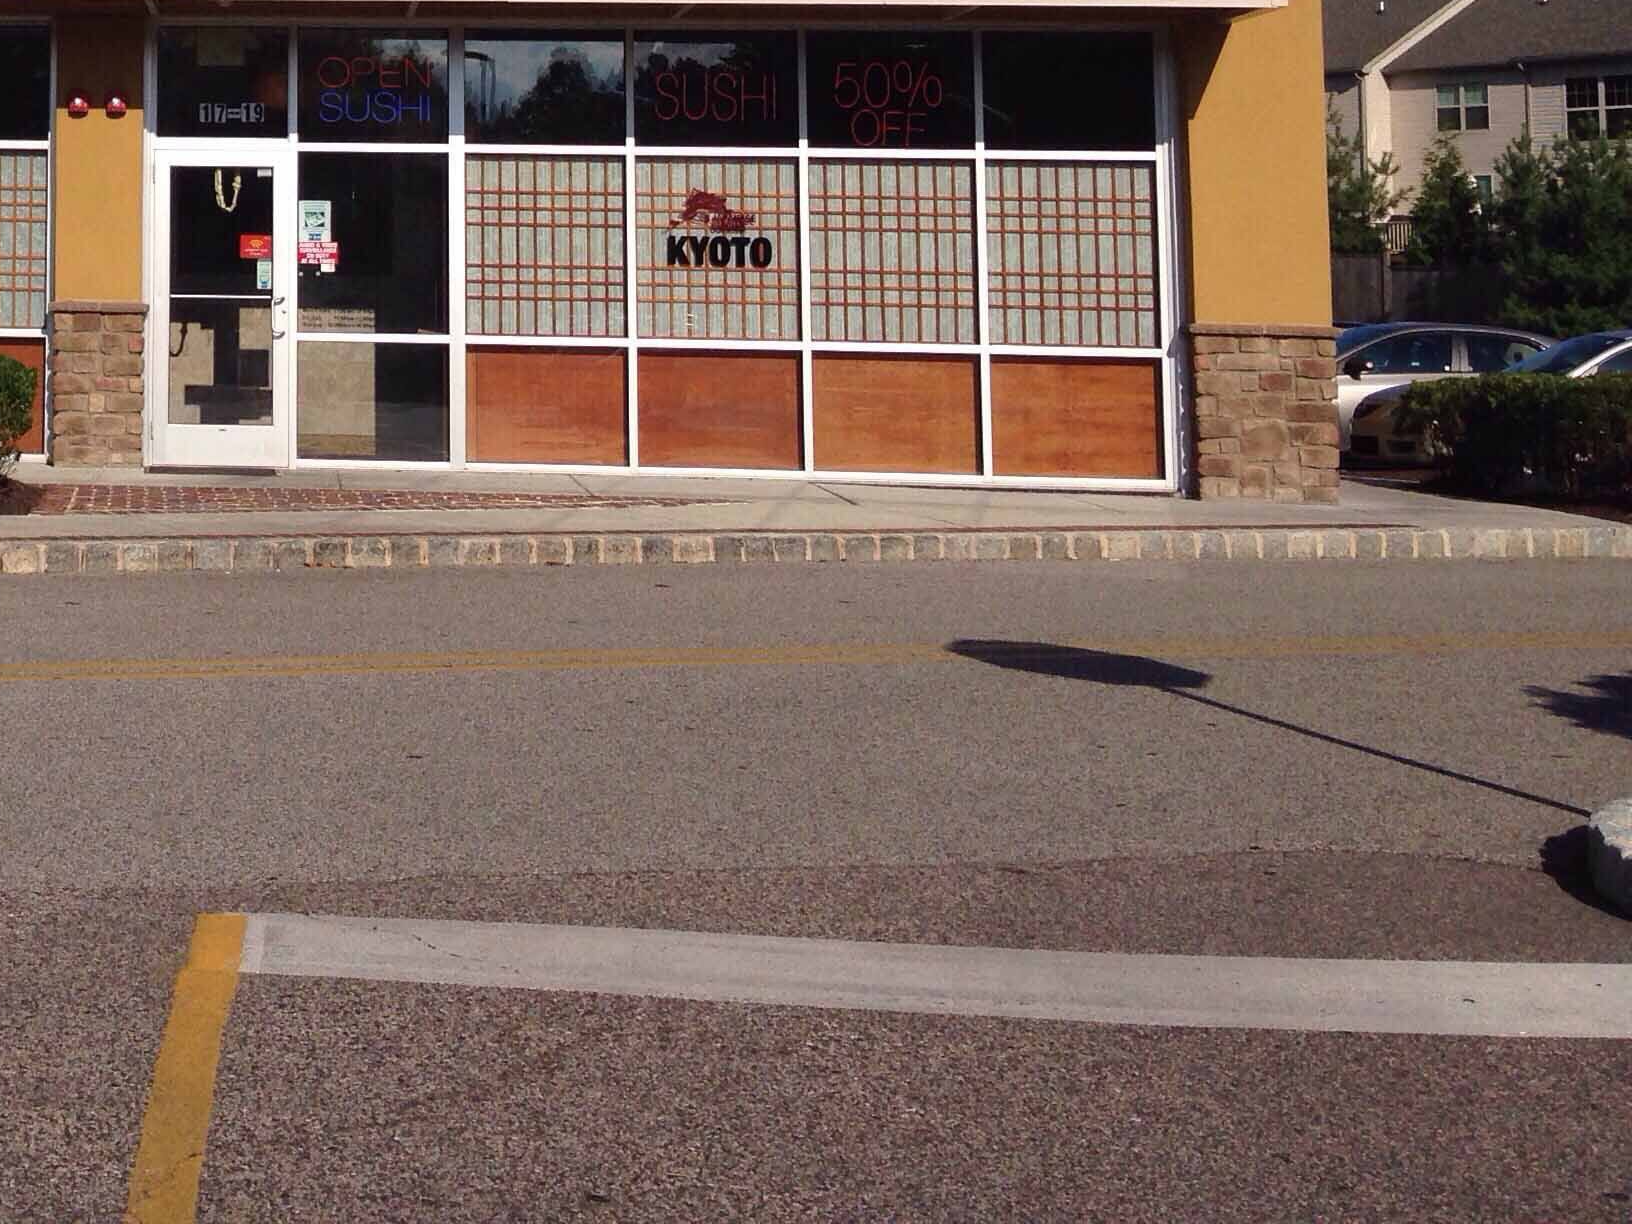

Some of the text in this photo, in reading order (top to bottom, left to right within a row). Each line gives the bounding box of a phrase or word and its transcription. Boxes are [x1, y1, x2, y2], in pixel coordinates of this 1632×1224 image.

[319, 56, 431, 88] OPEN
[834, 61, 943, 108] 50%
[319, 90, 432, 123] SUSHI
[654, 71, 778, 122] SUSHI
[851, 109, 928, 147] OFF
[667, 235, 773, 268] KYOTO
